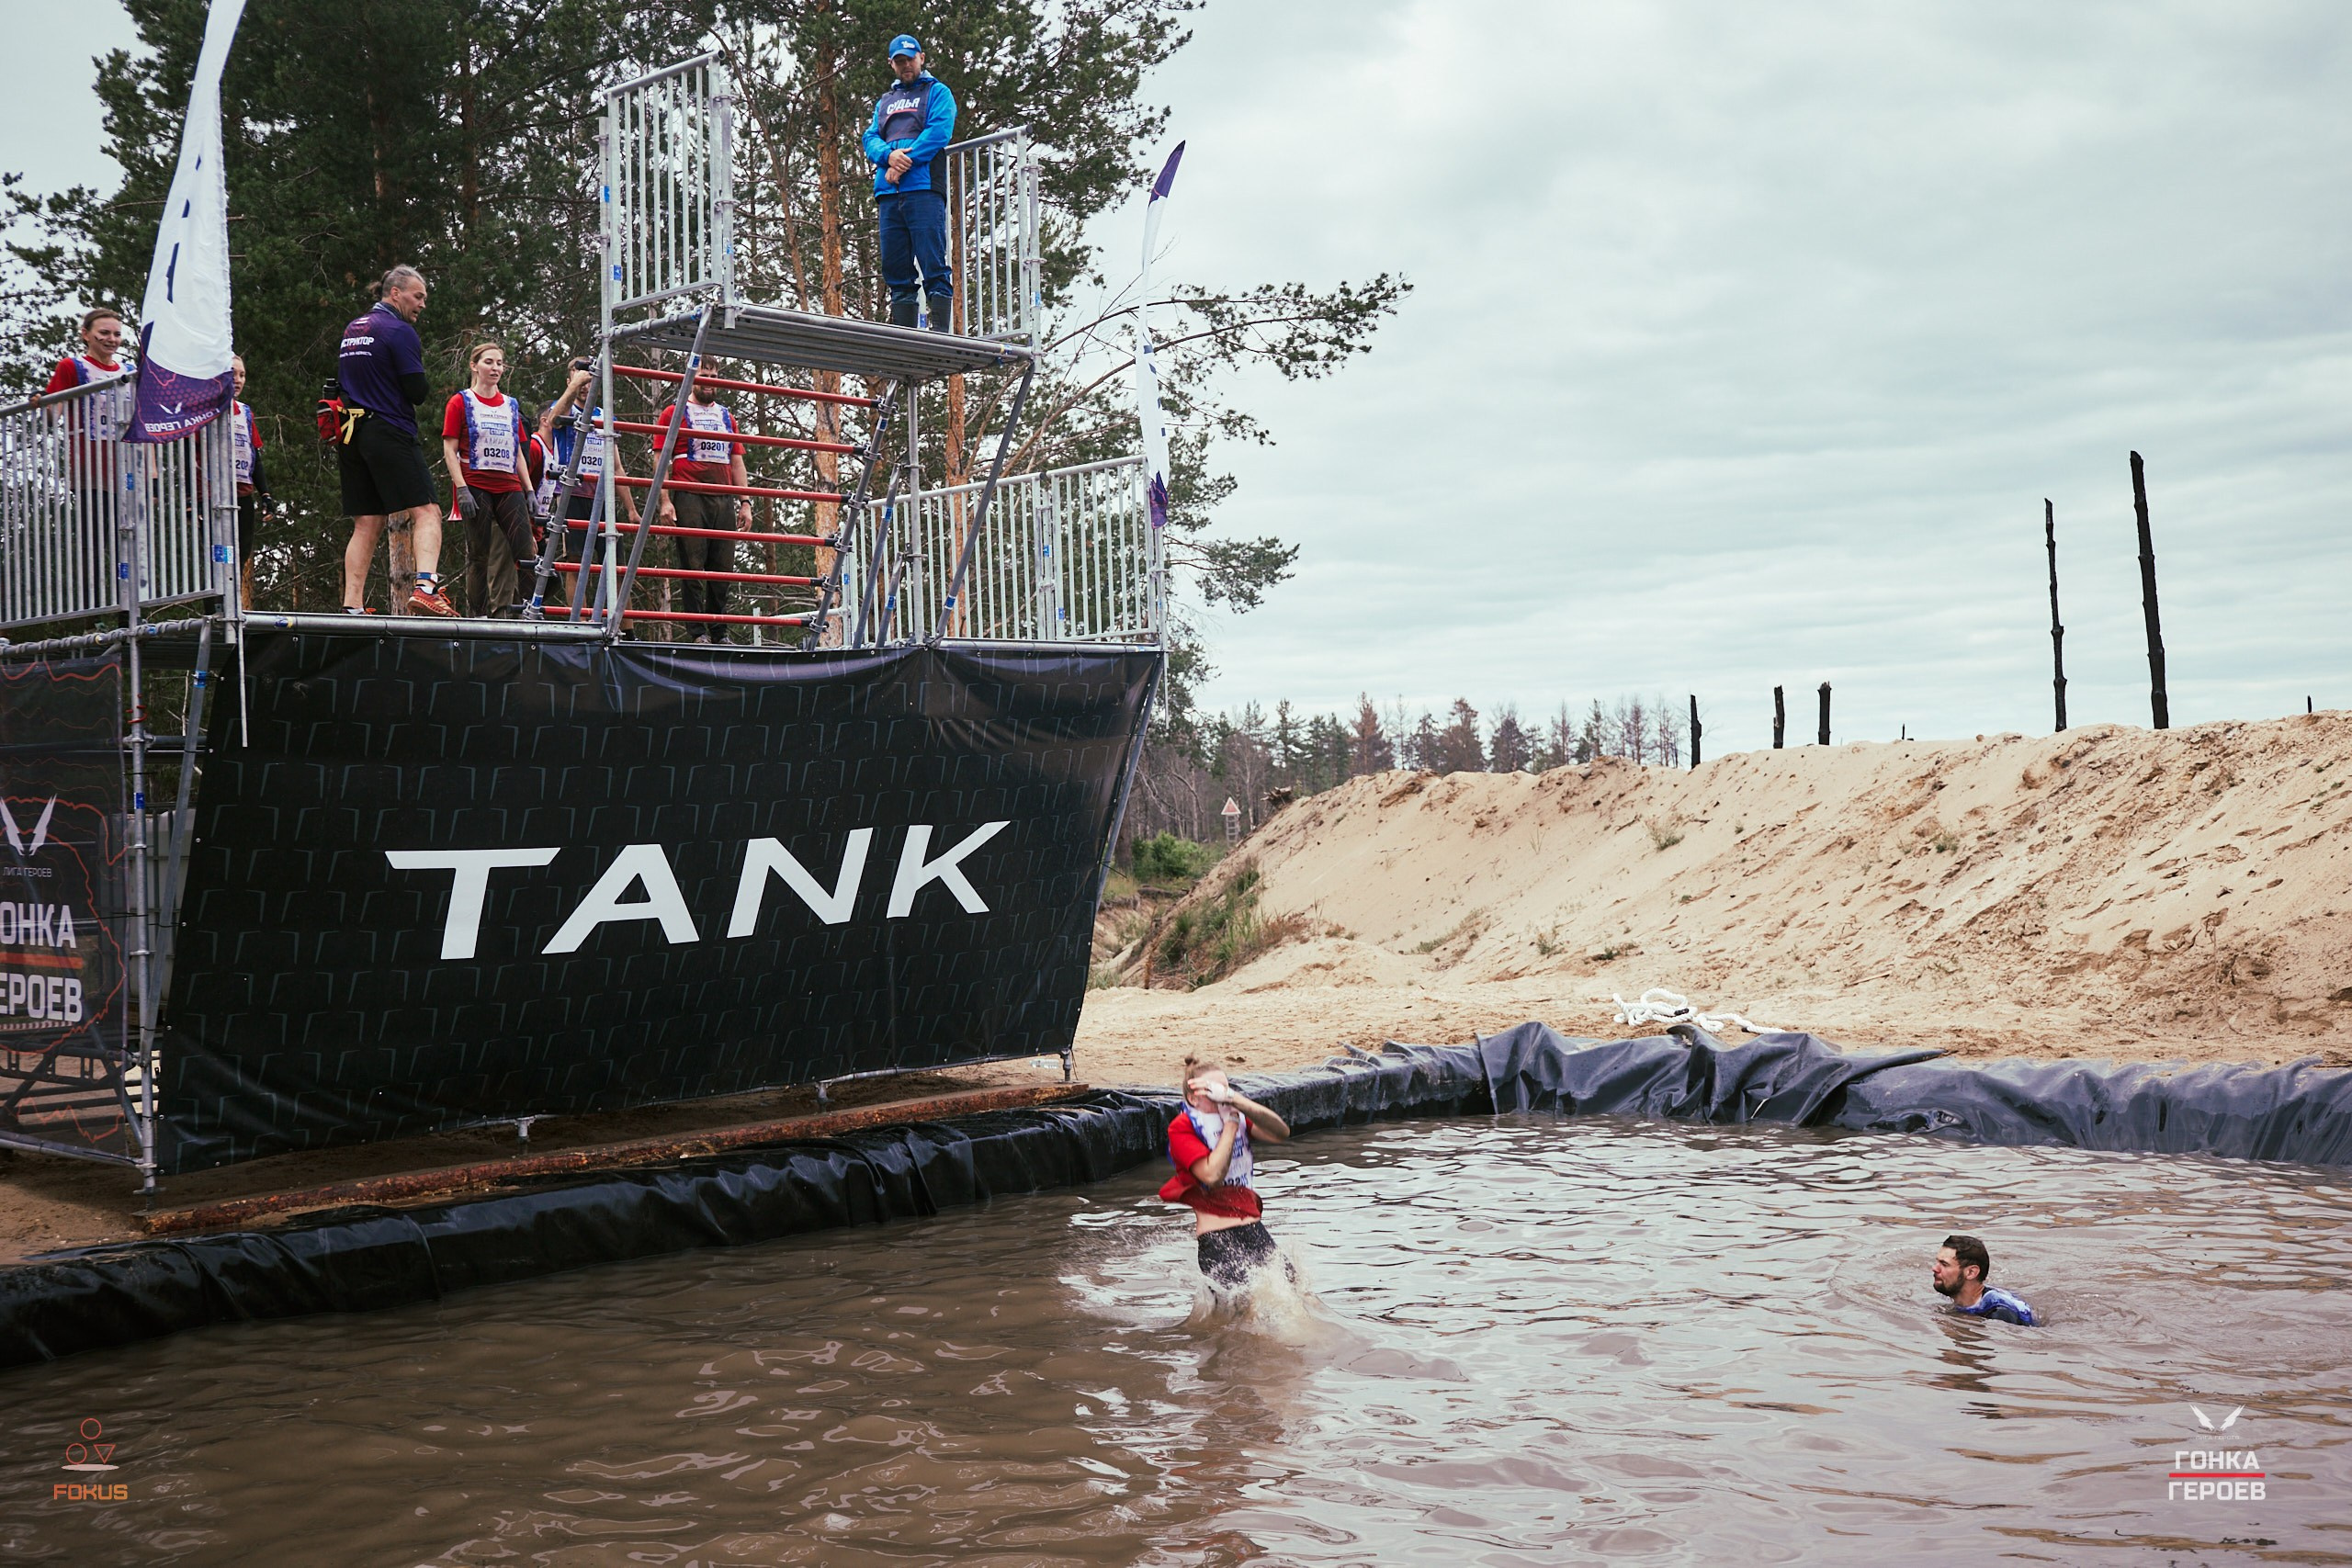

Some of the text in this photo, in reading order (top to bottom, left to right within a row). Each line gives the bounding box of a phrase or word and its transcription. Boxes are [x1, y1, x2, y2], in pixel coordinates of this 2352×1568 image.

[887, 97, 920, 114] СУДЬЯ
[483, 447, 510, 459] 03208
[700, 441, 725, 451] 03201
[582, 457, 603, 467] 0320
[3, 866, 52, 877] ЛИГА ГЕРОЕВ
[385, 820, 1011, 960] TANK
[0, 901, 77, 949] ОНКА
[0, 972, 83, 1022] ЕРОЕВ
